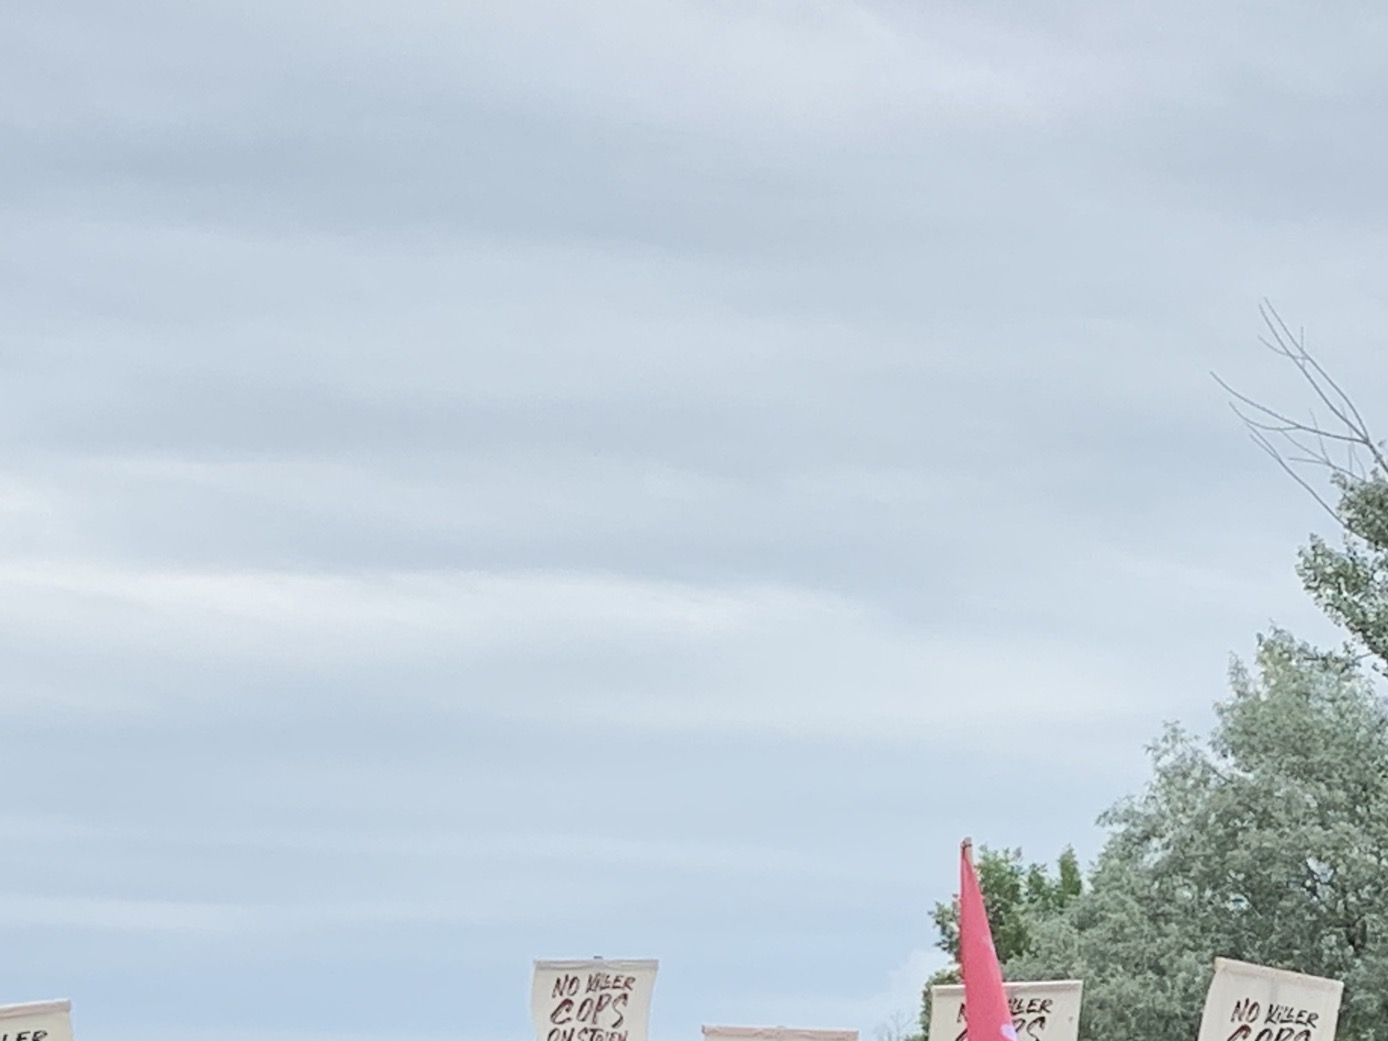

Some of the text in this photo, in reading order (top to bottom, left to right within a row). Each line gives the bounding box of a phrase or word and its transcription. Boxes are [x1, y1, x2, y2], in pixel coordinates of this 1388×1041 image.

[552, 974, 579, 998] NO
[550, 993, 628, 1028] COPS
[1230, 998, 1260, 1022] NO
